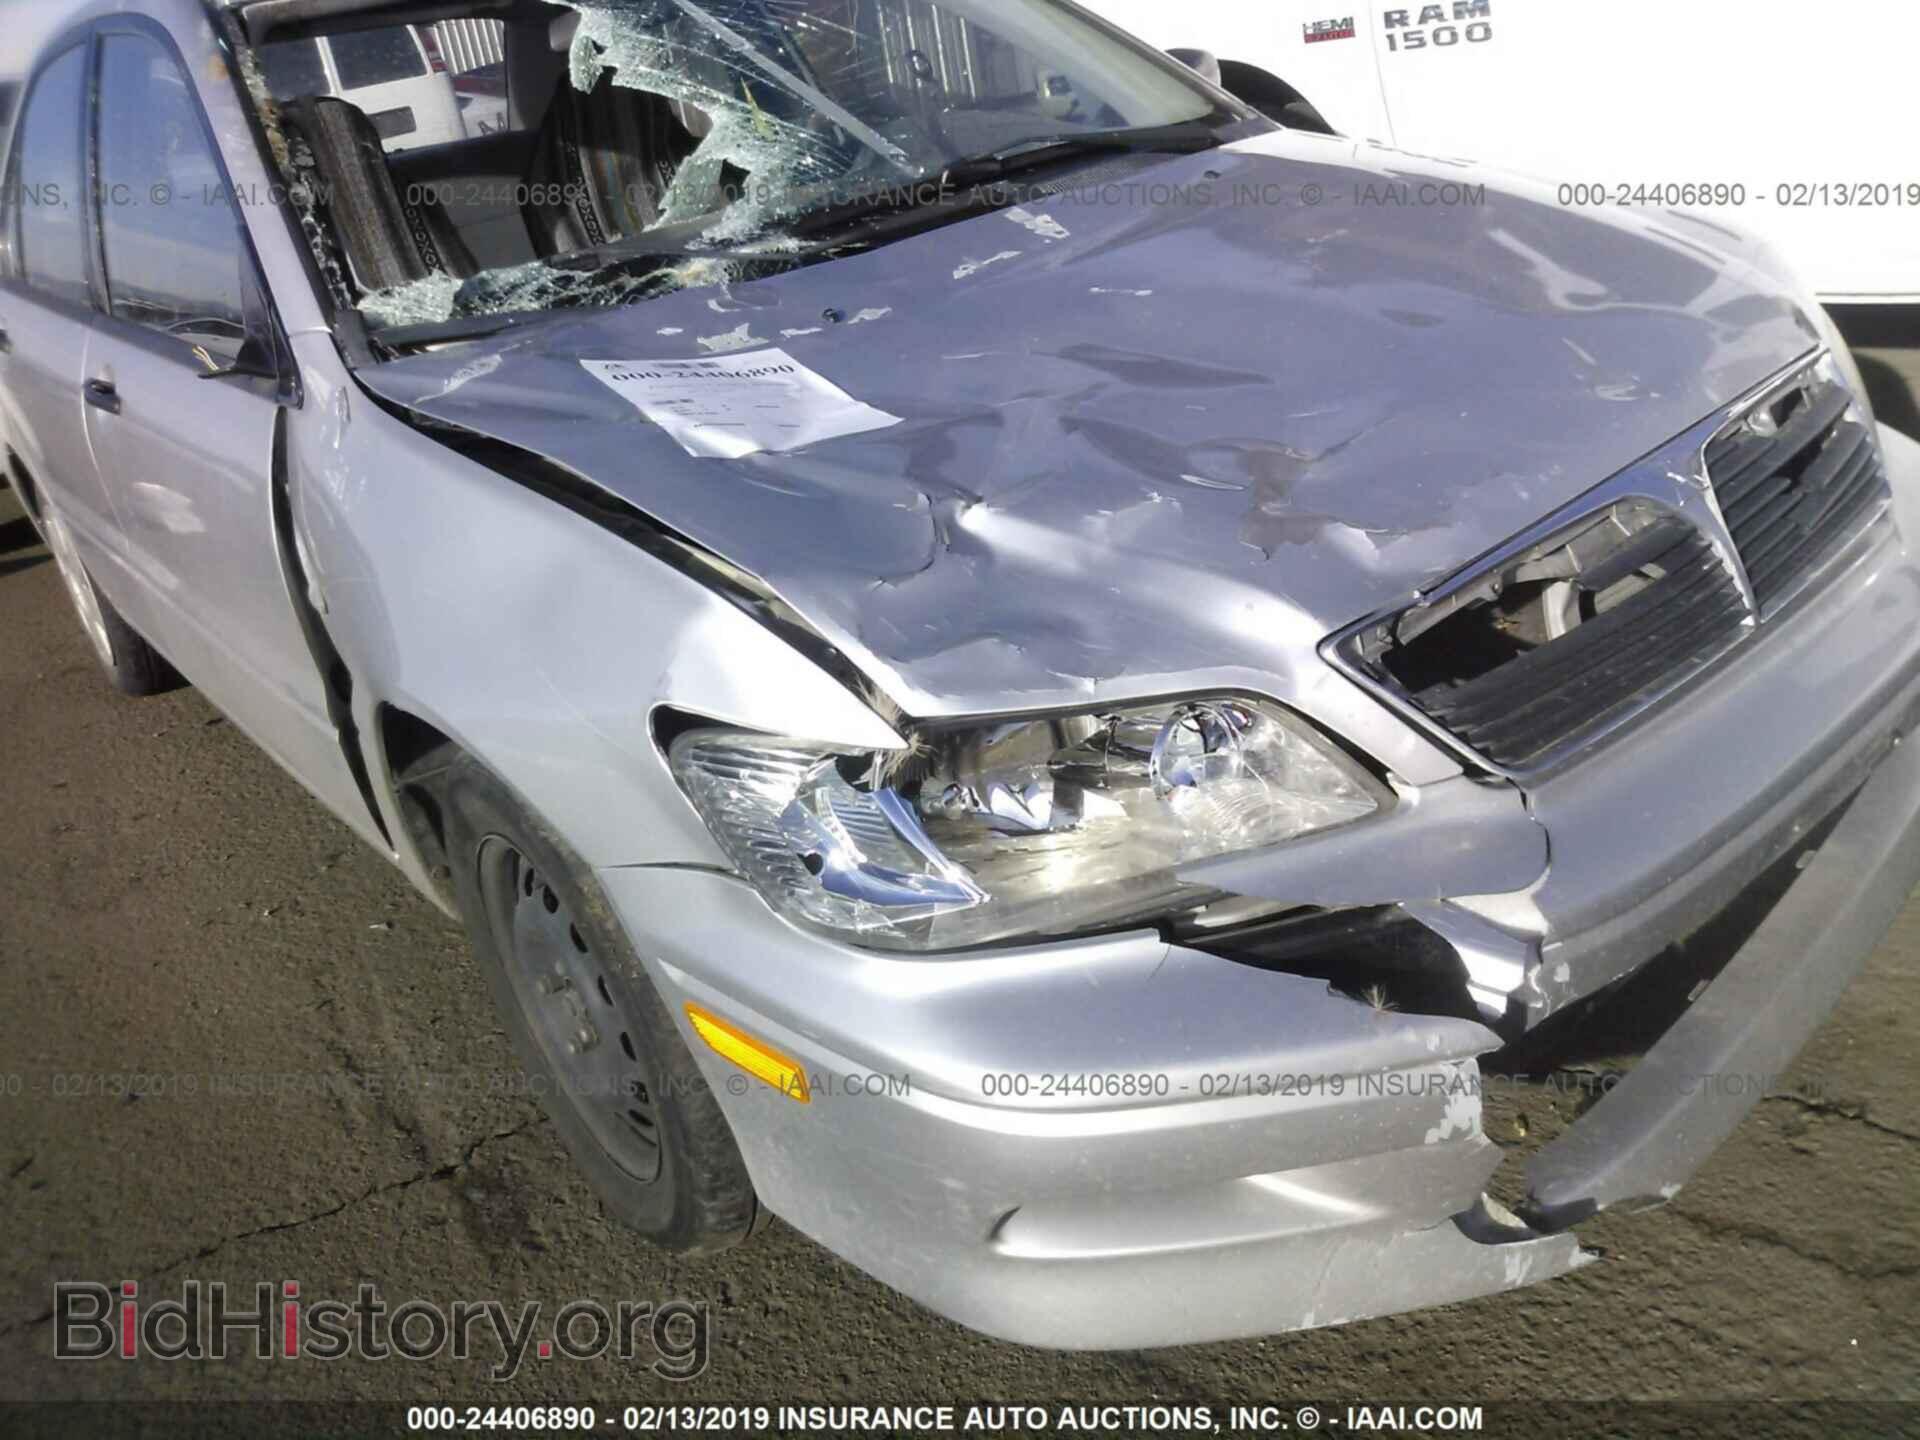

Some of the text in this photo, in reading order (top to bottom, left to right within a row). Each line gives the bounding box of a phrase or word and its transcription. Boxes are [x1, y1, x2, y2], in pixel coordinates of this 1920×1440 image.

[1302, 16, 1354, 34] HEMI
[1384, 0, 1490, 28] RAM
[1386, 22, 1492, 52] 1500
